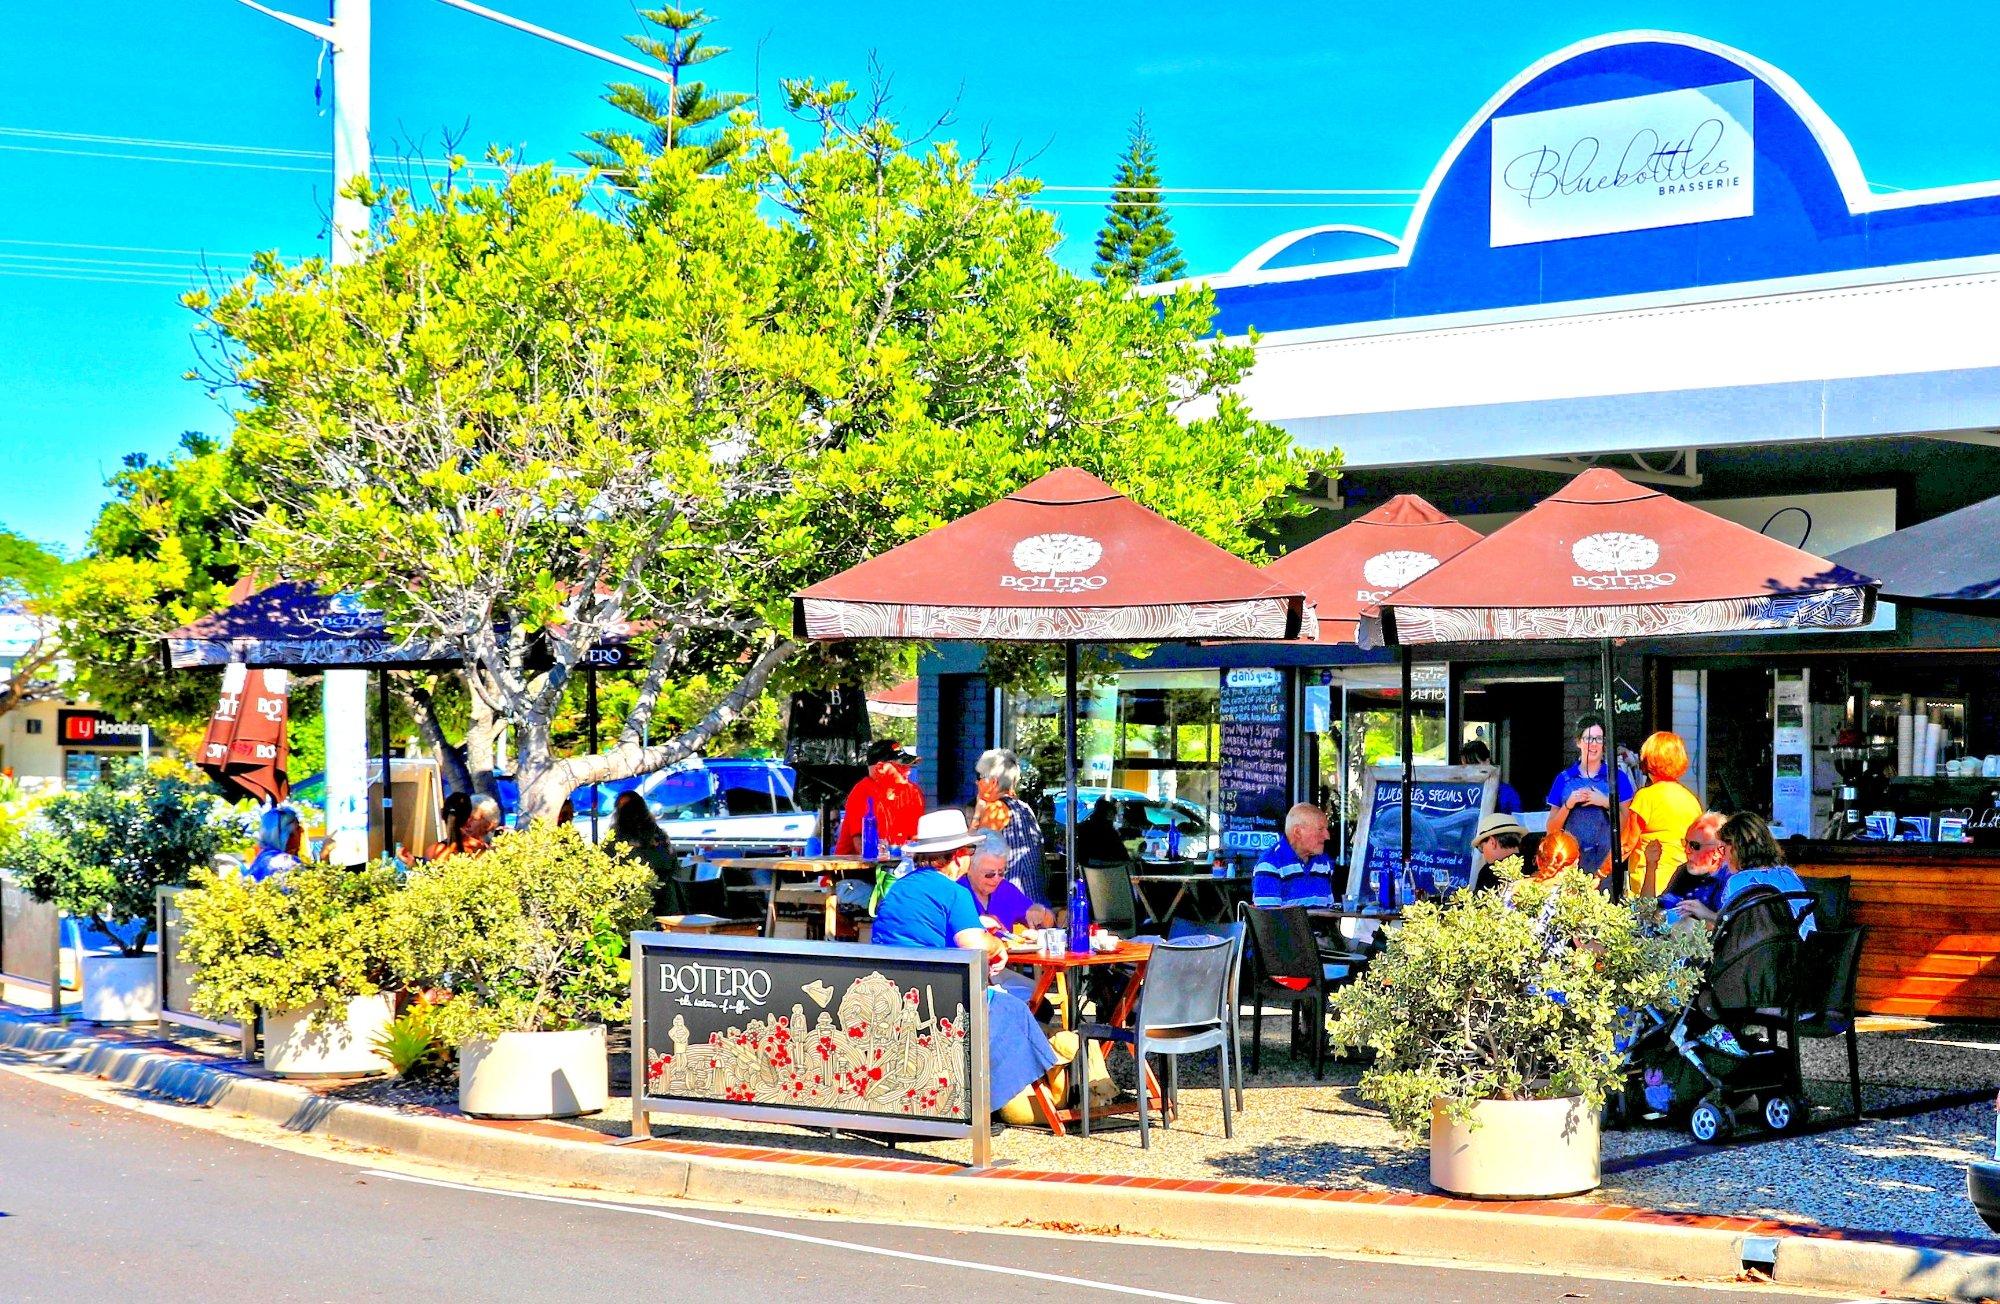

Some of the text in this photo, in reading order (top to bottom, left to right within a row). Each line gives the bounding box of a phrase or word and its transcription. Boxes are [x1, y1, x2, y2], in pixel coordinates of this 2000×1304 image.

[1503, 118, 1730, 209] Bluebottles
[1658, 177, 1741, 196] BRASSERIE
[999, 575, 1108, 590] BOTERO
[1571, 572, 1677, 587] BOTERO
[94, 720, 143, 735] Hooke
[1236, 724, 1254, 738] MANY
[1428, 788, 1464, 802] SPECIALS
[660, 961, 772, 1006] BOTERO
